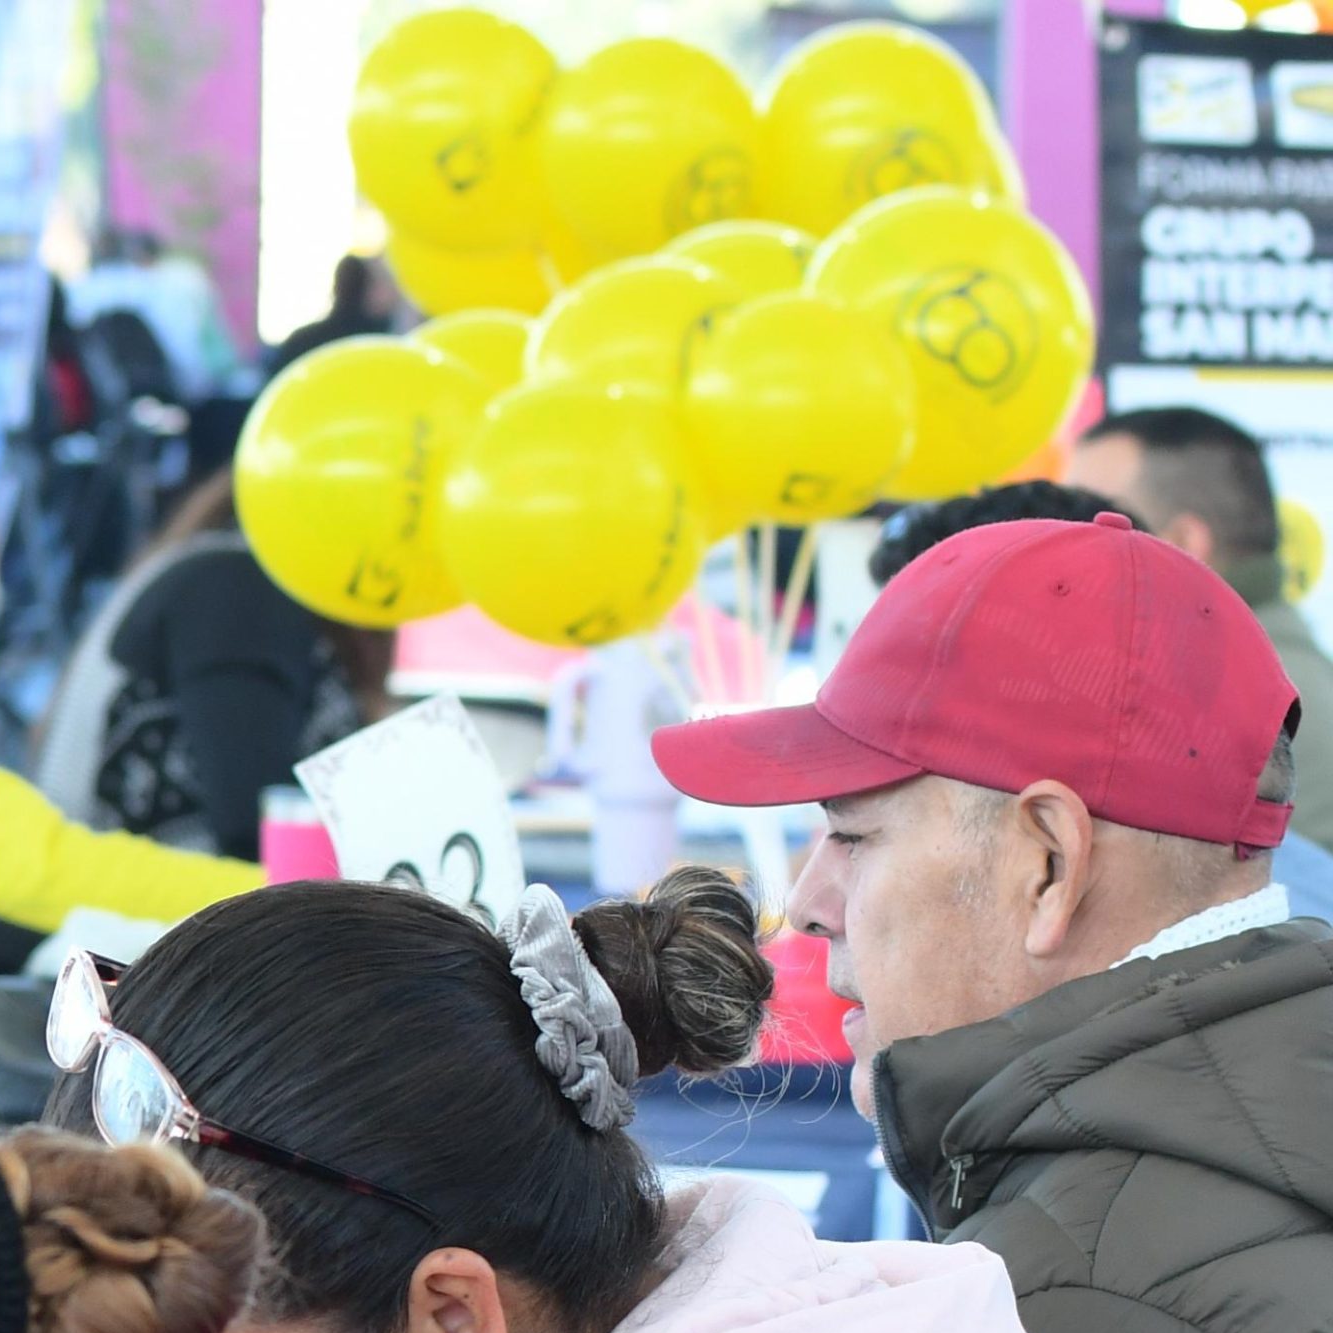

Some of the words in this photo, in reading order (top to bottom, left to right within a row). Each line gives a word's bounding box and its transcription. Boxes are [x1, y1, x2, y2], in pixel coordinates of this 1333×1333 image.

[1138, 155, 1265, 199] FORMA
[1141, 207, 1313, 259] GRUPO
[1140, 308, 1247, 360] SAN
